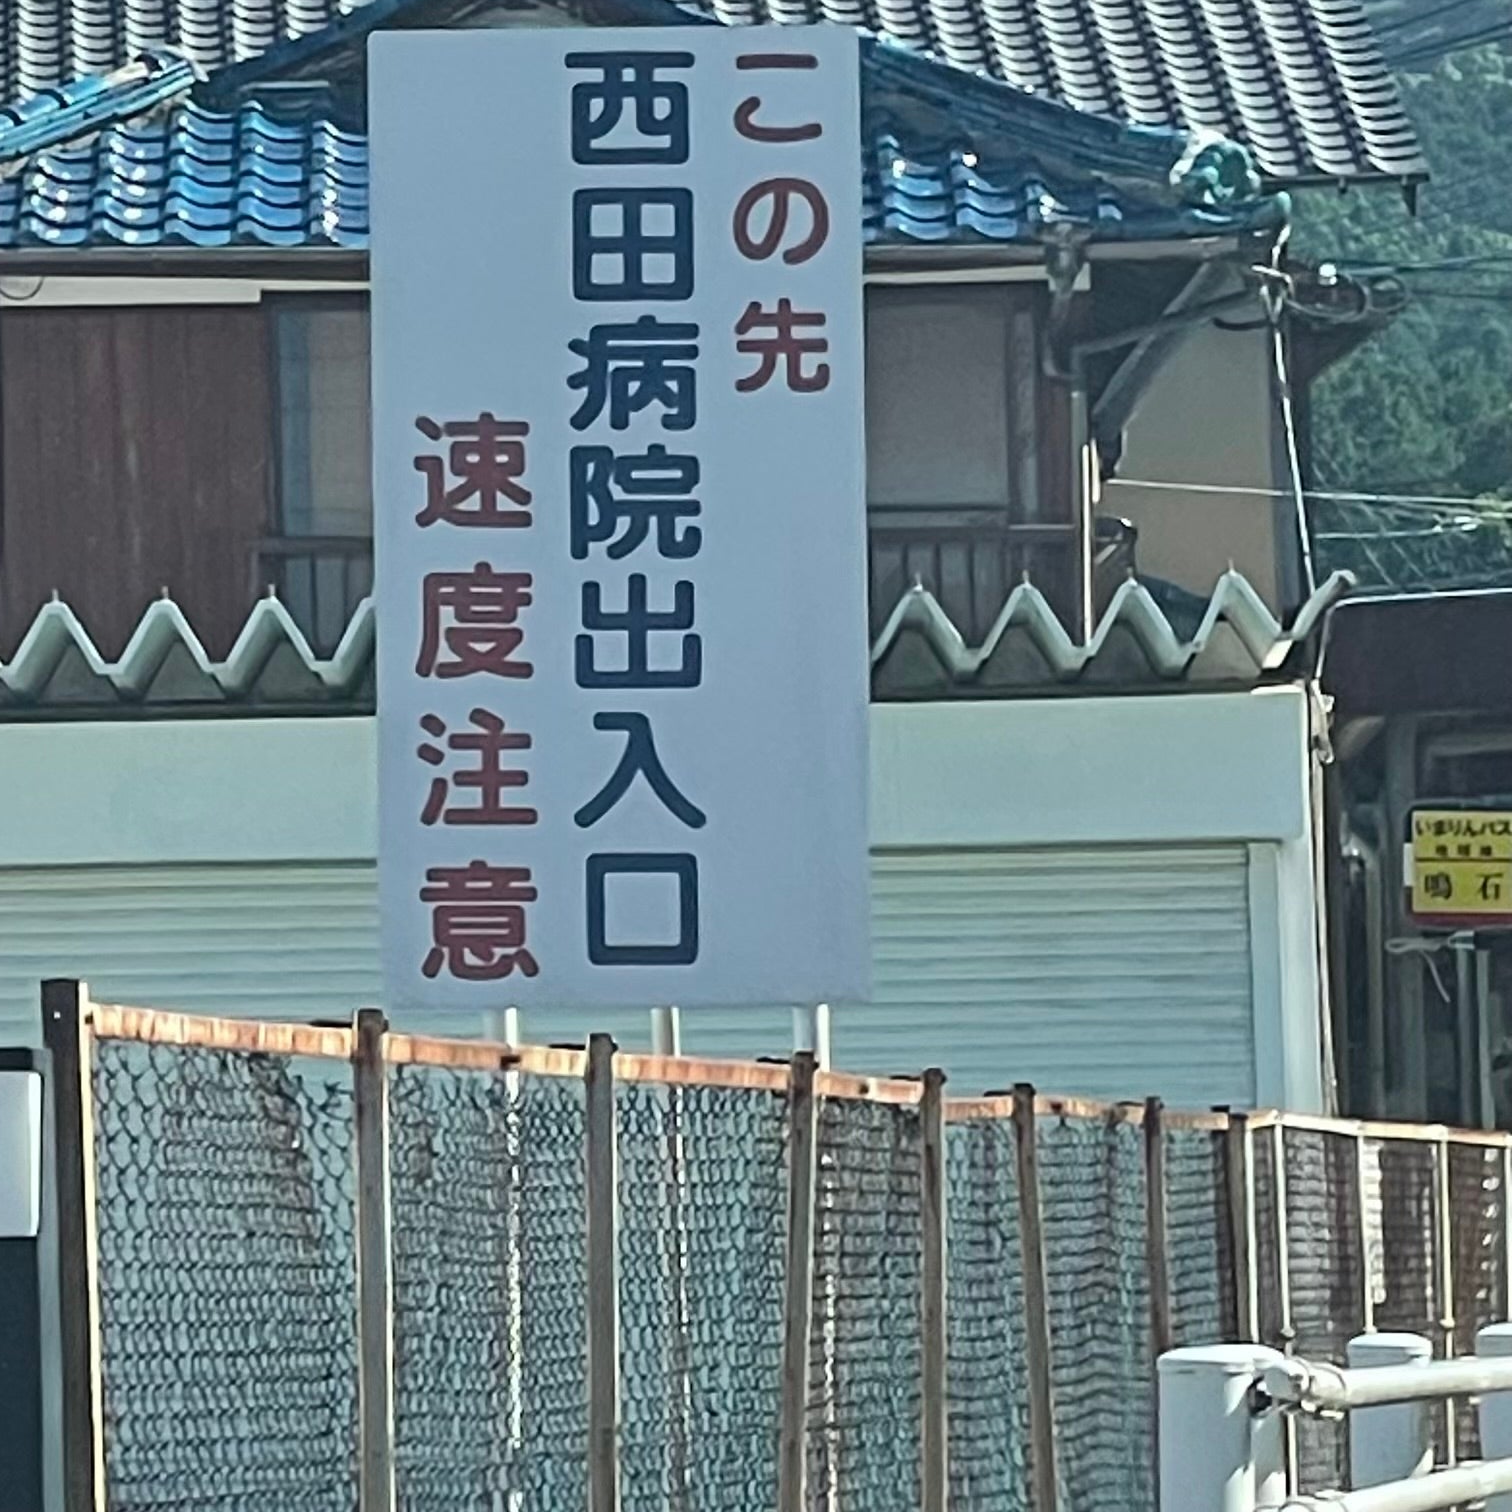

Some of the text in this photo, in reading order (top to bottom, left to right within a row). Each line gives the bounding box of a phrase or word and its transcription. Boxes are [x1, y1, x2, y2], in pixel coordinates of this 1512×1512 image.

[563, 50, 707, 966] 西田病院出入口
[732, 53, 831, 393] この先
[412, 411, 540, 982] 速度注意
